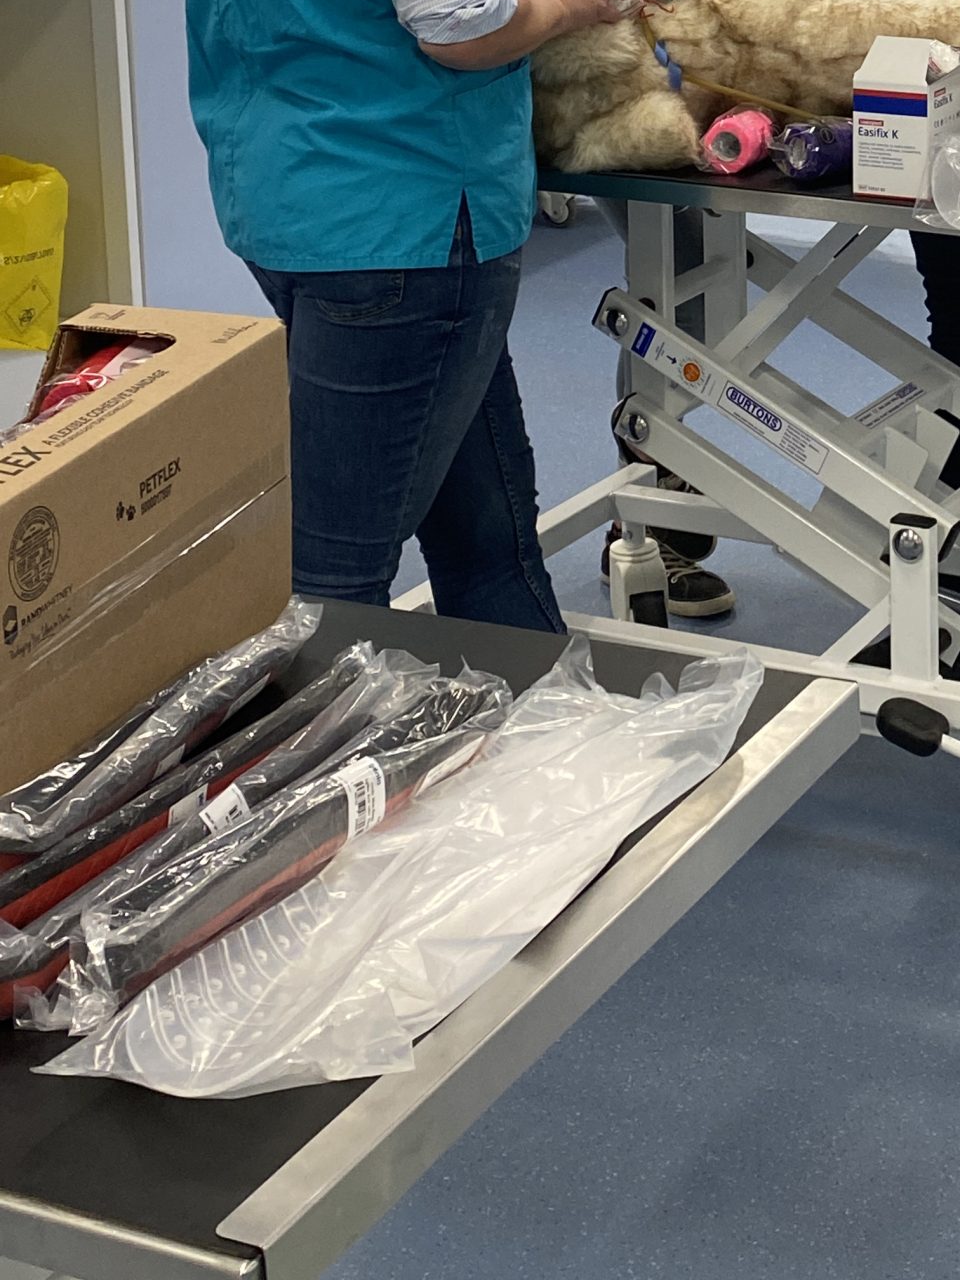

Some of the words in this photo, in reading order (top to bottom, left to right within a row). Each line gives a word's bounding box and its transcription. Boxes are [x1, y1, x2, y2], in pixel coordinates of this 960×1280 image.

[858, 126, 889, 139] Easifix
[891, 129, 900, 140] K
[42, 436, 54, 446] A
[50, 416, 90, 442] FLEXIBLE
[86, 389, 131, 420] COHESIVE
[127, 369, 170, 396] BANDAGE
[729, 387, 779, 429] BURTONS
[0, 445, 52, 484] LEX
[139, 456, 182, 499] PETFLEX
